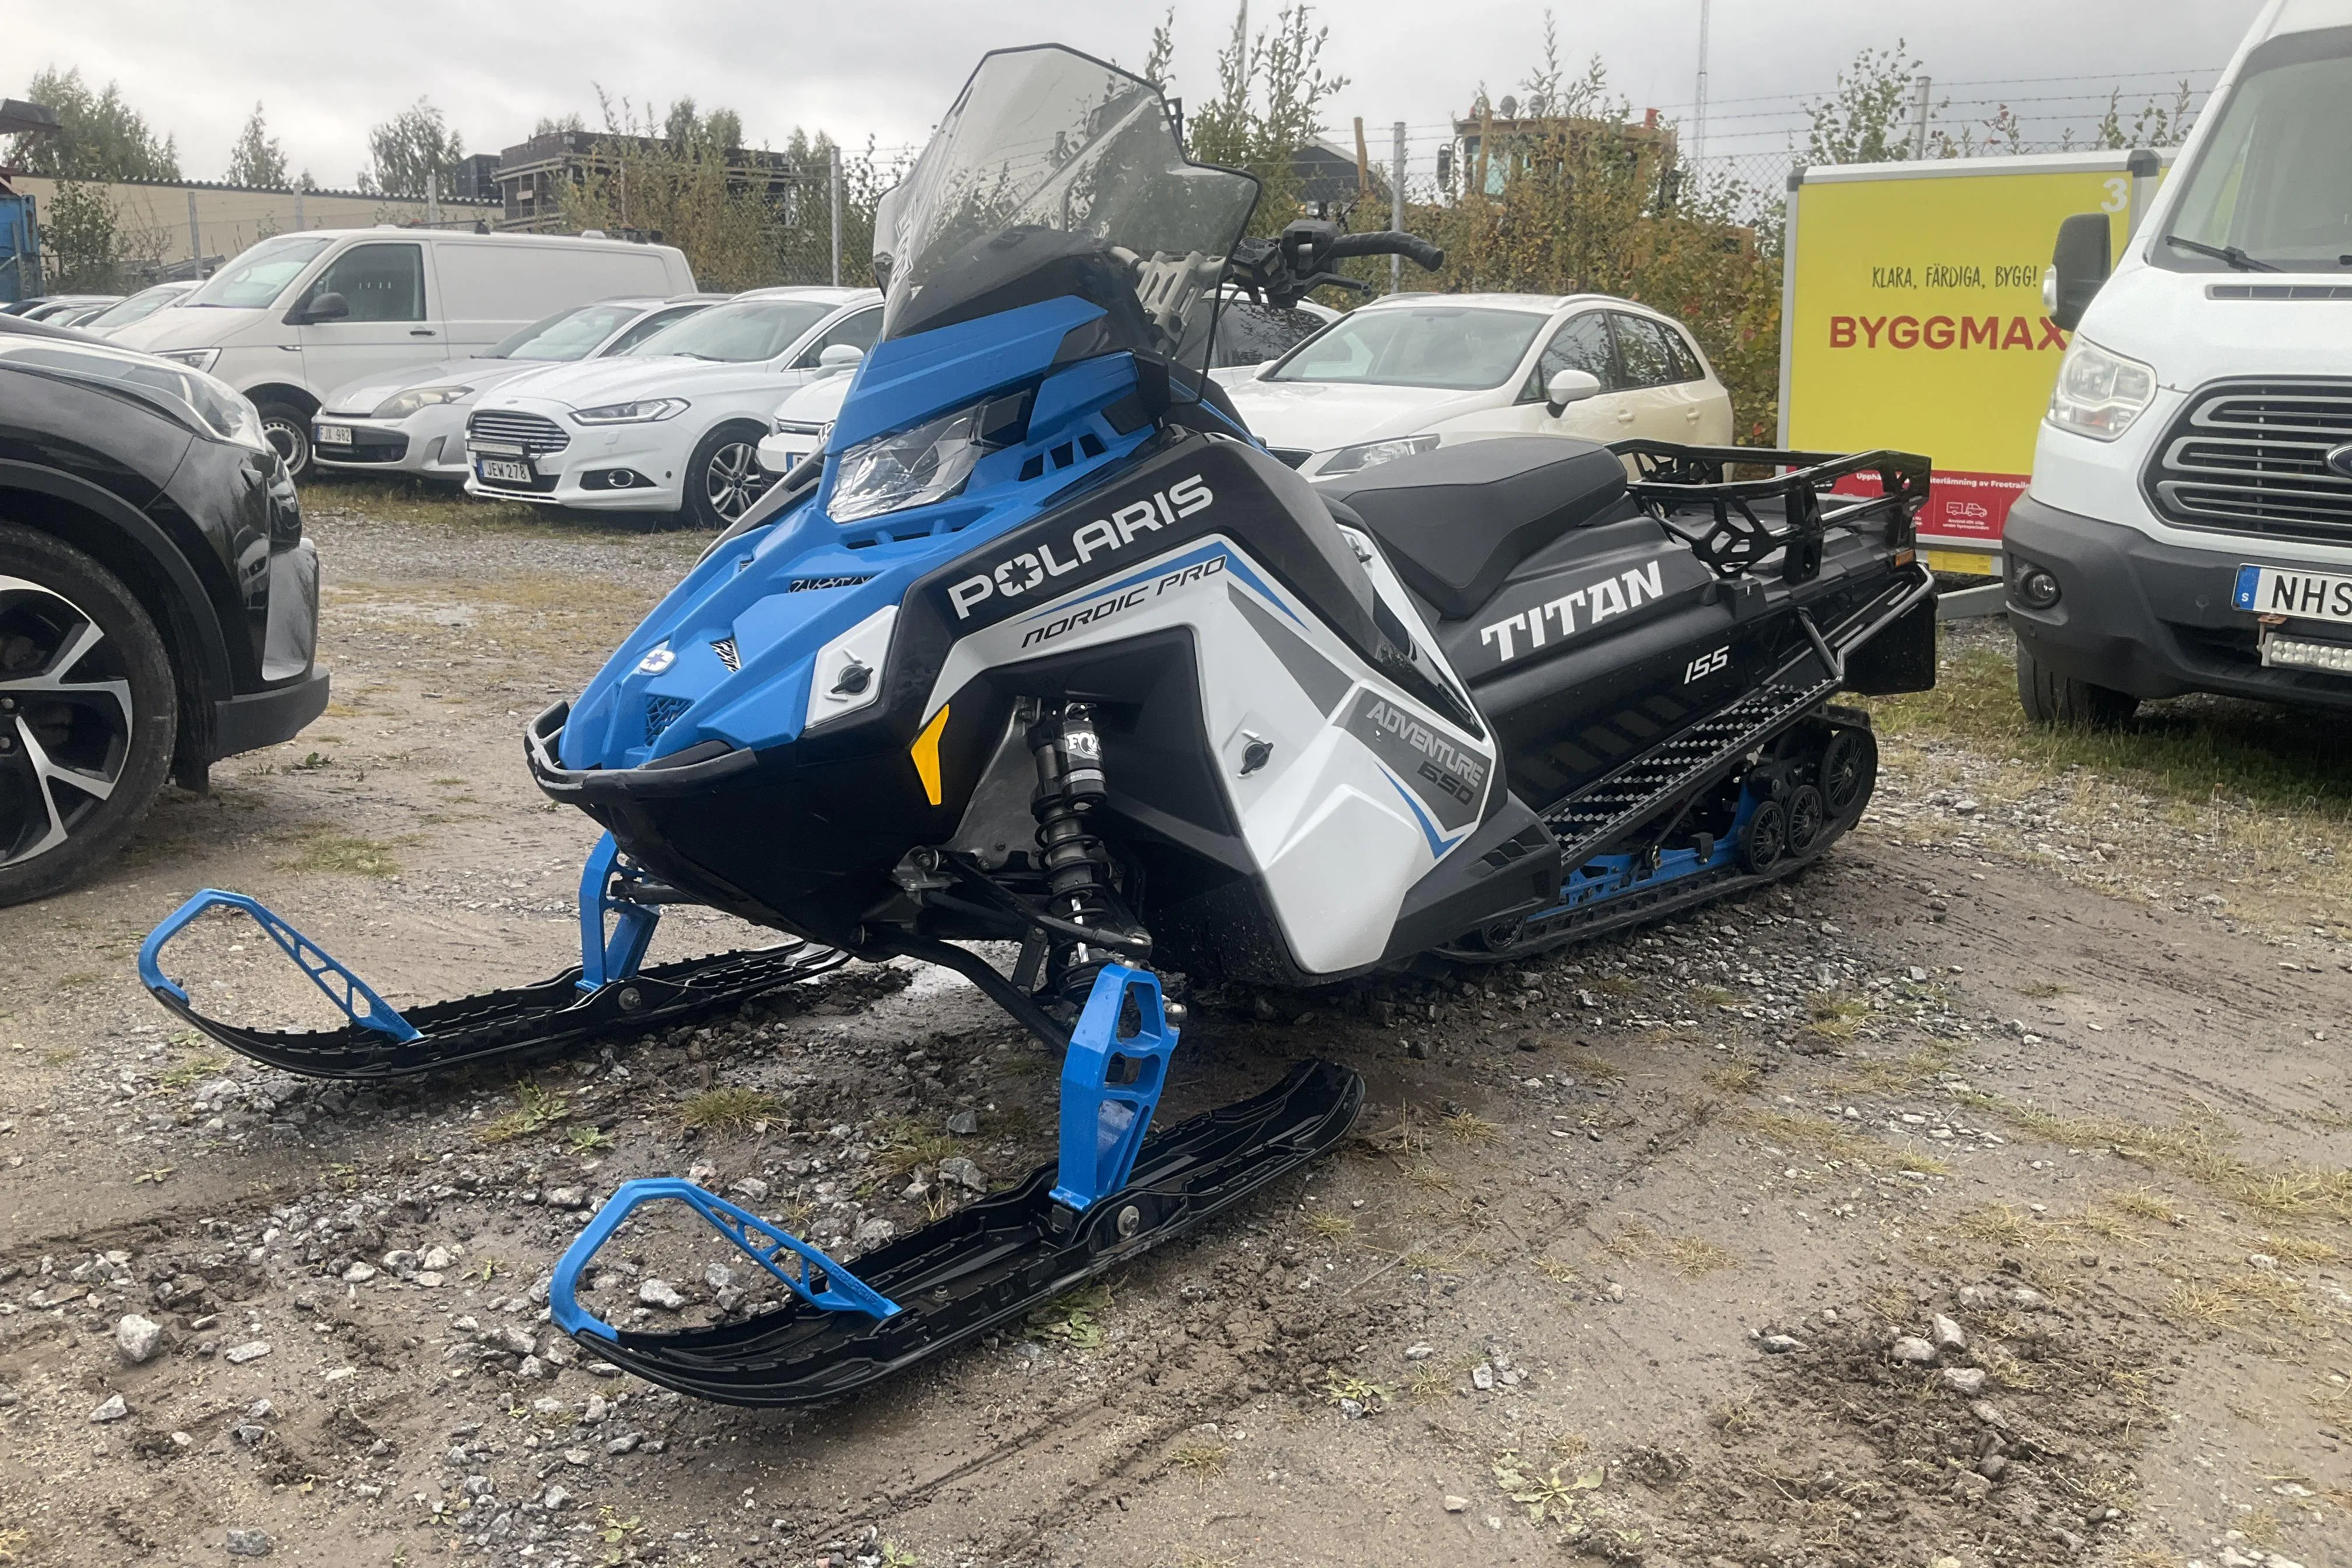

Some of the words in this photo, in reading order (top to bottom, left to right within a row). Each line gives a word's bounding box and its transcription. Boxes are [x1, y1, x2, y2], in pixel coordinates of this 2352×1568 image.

[2101, 177, 2128, 212] 3
[1872, 267, 1917, 290] KLARA,
[1925, 263, 1986, 289] FÄRDIGA,
[1994, 265, 2038, 288] BYGG!
[1829, 316, 2068, 351] BYGGMAX
[487, 461, 505, 477] JEW
[506, 462, 526, 480] 278
[947, 474, 1214, 621] POLARIS
[1021, 586, 1149, 649] NORDIC
[1156, 554, 1227, 596] PRO
[1480, 560, 1665, 662] TITAN
[2271, 575, 2352, 617] NHS
[1684, 645, 1730, 685] 155
[1066, 732, 1101, 759] FOX
[1366, 700, 1485, 789] ADVENTURE
[1416, 760, 1474, 806] 650
